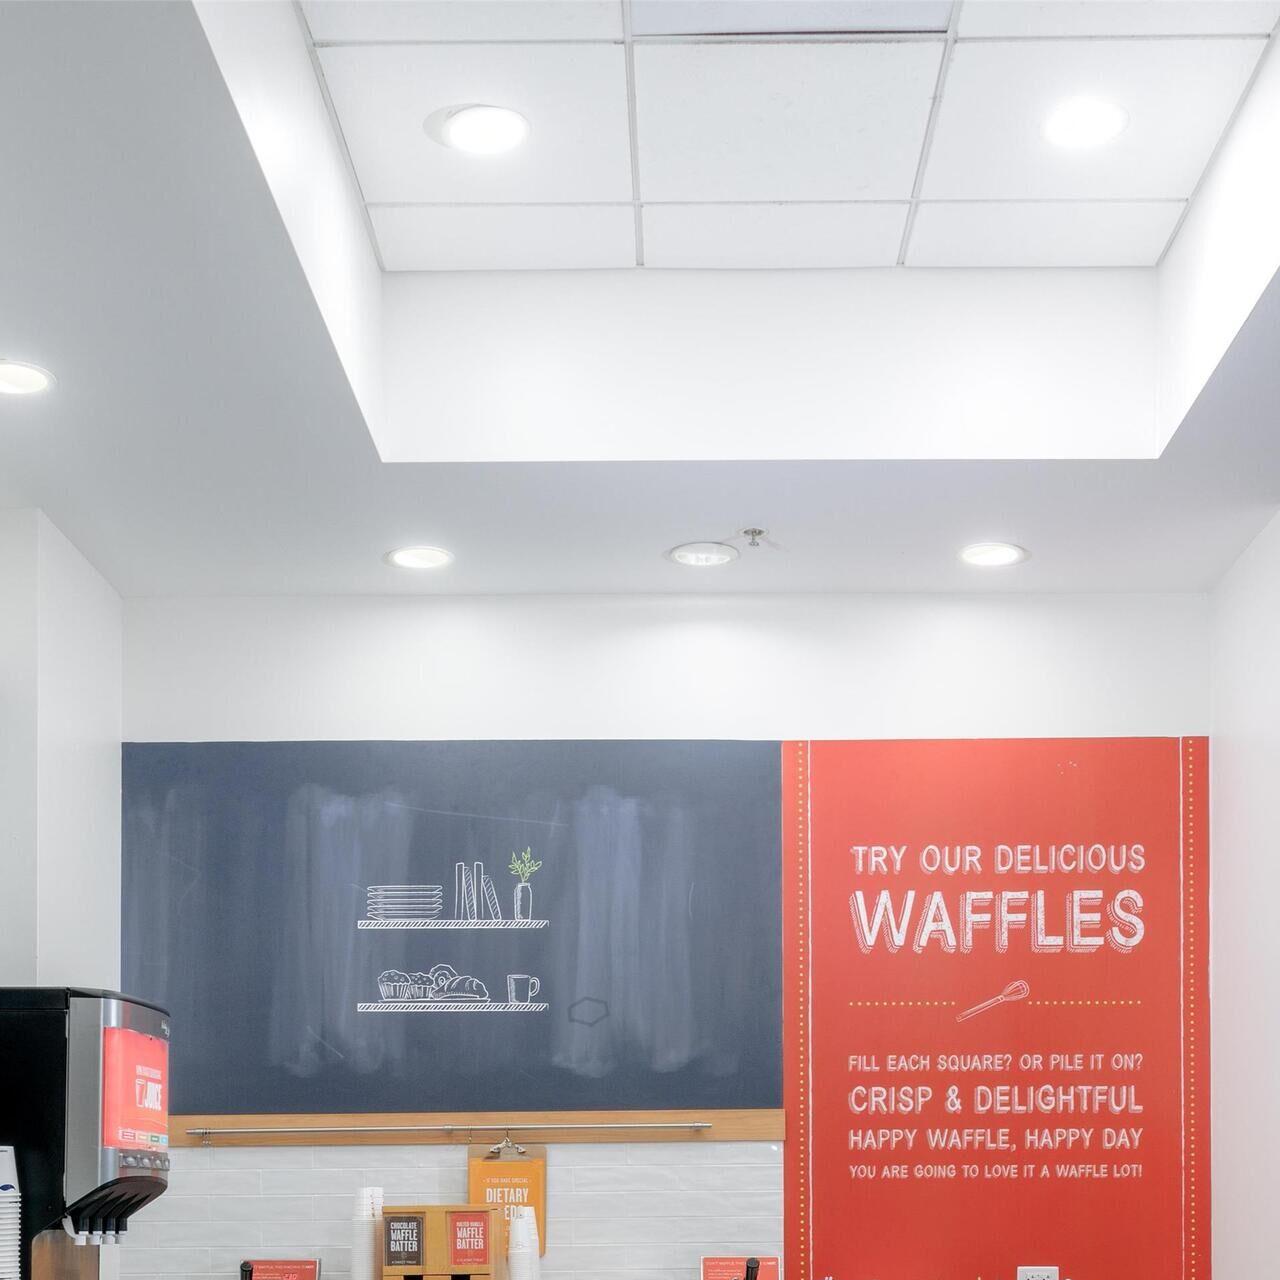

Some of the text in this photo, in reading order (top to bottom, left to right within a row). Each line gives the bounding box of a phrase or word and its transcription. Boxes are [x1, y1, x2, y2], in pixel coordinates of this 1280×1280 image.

[851, 844, 1145, 874] TRY OUR DELICIOUS
[849, 889, 1145, 953] WAFFLES
[848, 1053, 1143, 1072] FILL EACH SQUARE? OR PILE IT ON?
[848, 1084, 1143, 1115] CRISP & DELIGHTFUL
[848, 1128, 1143, 1152] HAPPY WAFFLE, HAPPY DAY
[849, 1164, 1142, 1179] YOU ARE GOING TO LOVE IT A WAFFLE LOT!
[486, 1188, 529, 1203] DIETARY
[390, 1230, 418, 1240] WAFFLE
[456, 1227, 484, 1238] WAFFLE
[390, 1241, 418, 1252] BATTER
[456, 1239, 484, 1250] BATTER
